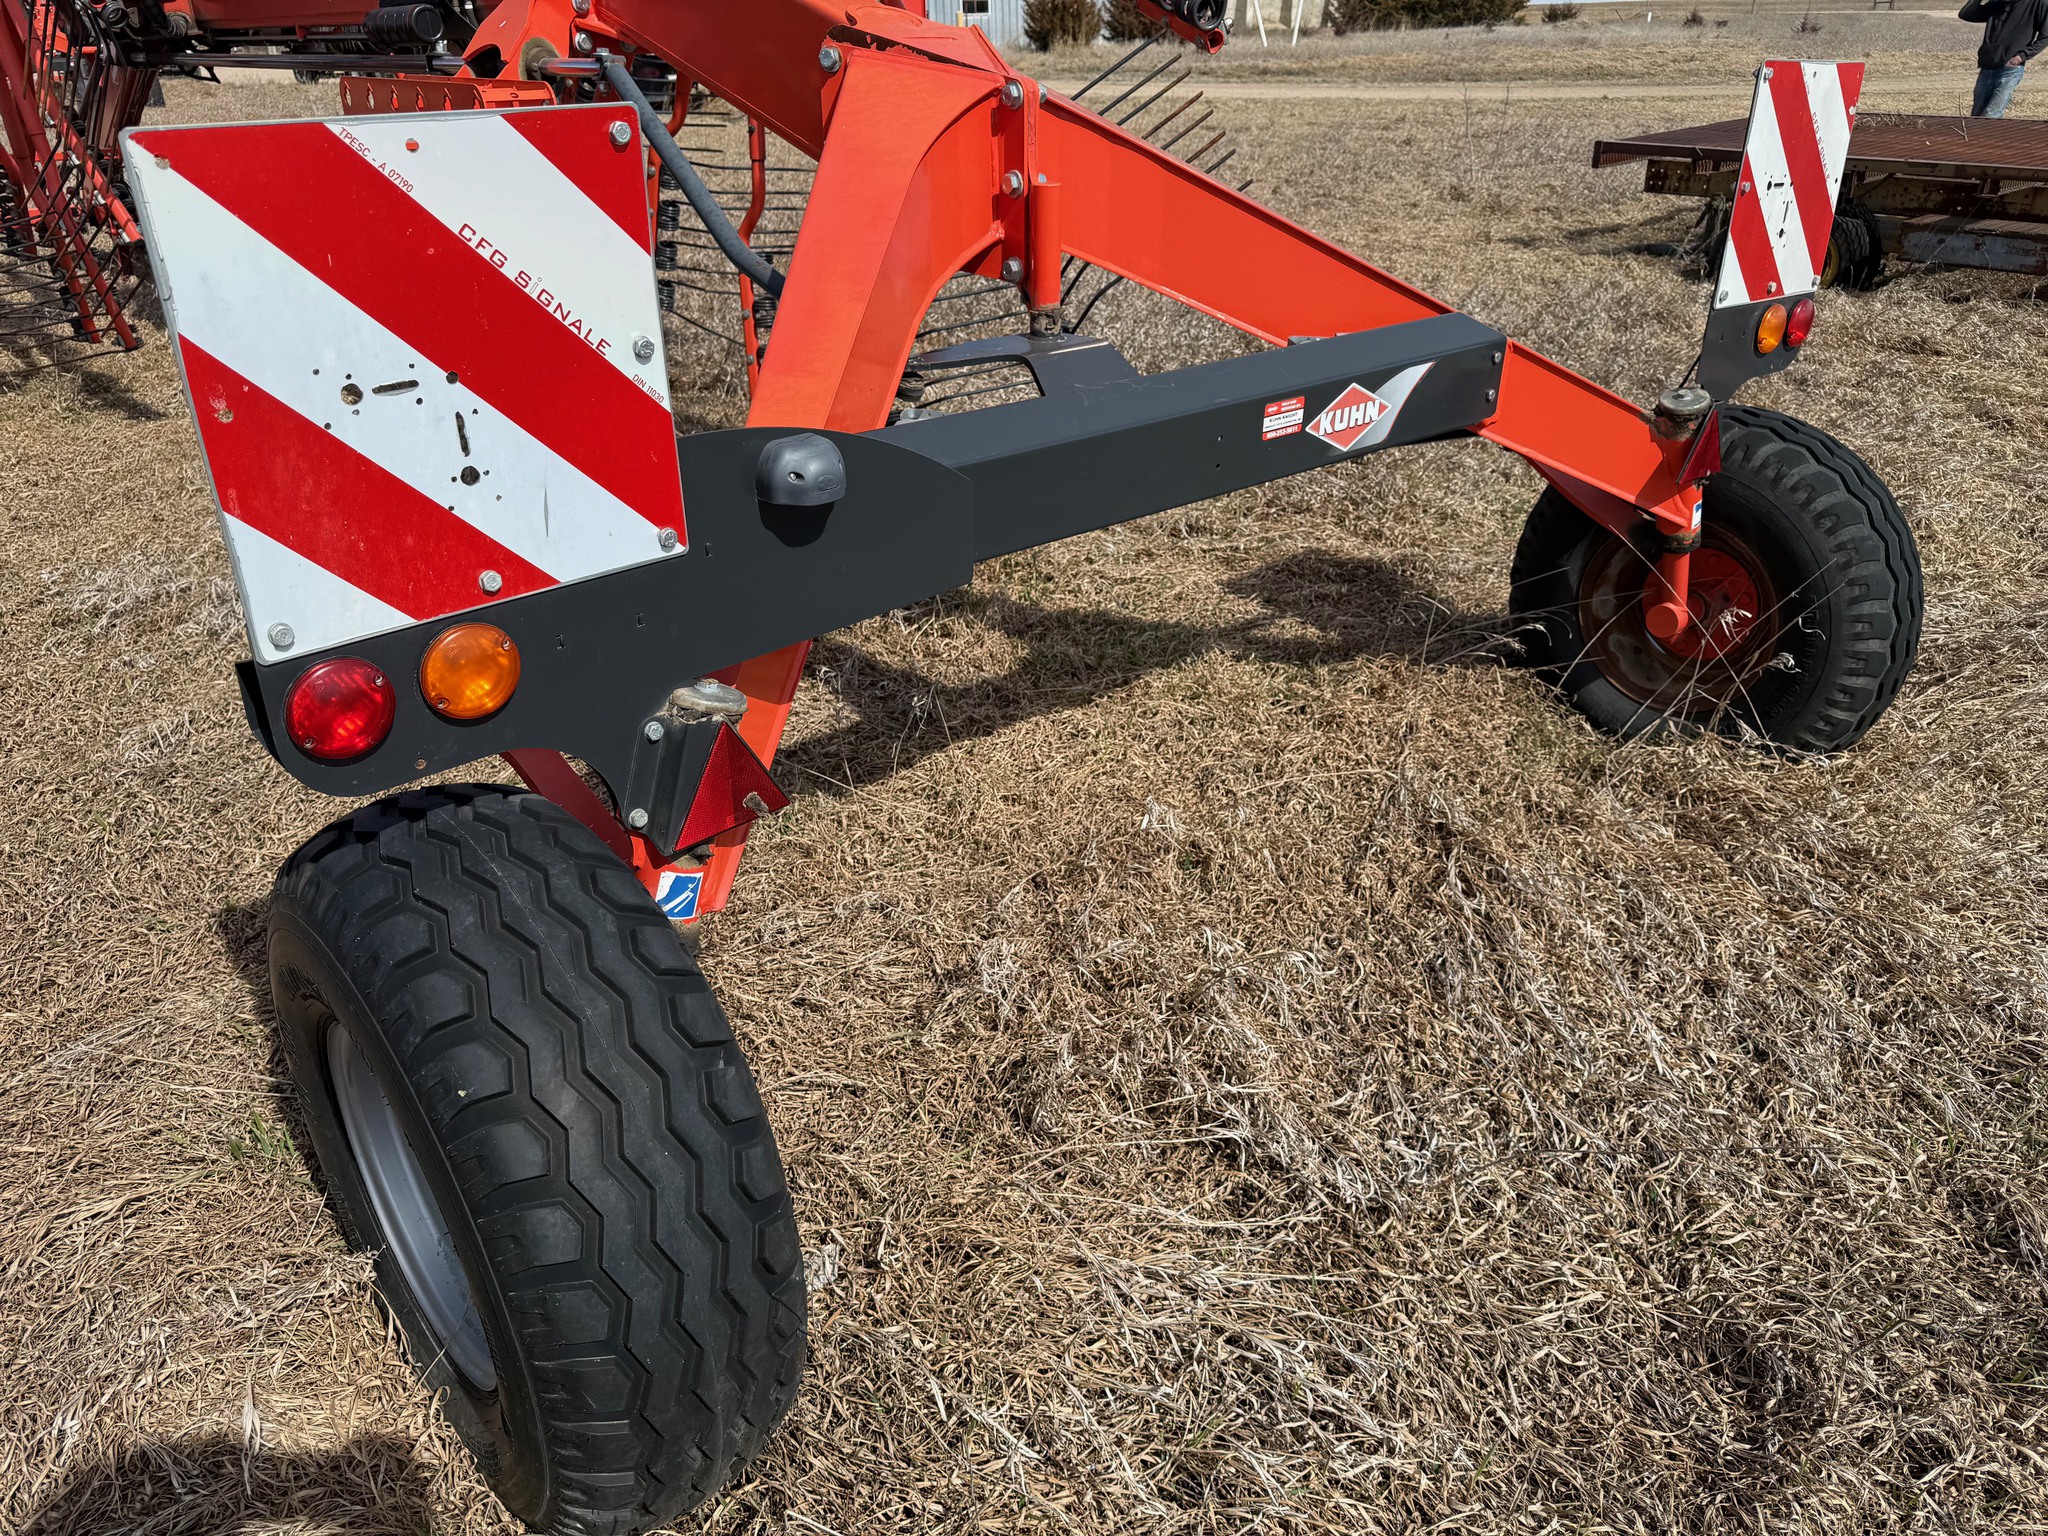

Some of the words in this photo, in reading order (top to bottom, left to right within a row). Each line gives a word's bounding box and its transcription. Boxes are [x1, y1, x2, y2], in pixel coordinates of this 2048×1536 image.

[339, 126, 371, 157] TPESC
[378, 162, 387, 172] A
[387, 169, 414, 193] 07190
[458, 223, 508, 269] CFG
[632, 373, 647, 388] DIN
[646, 385, 665, 404] 11030
[1318, 399, 1380, 436] KUHN
